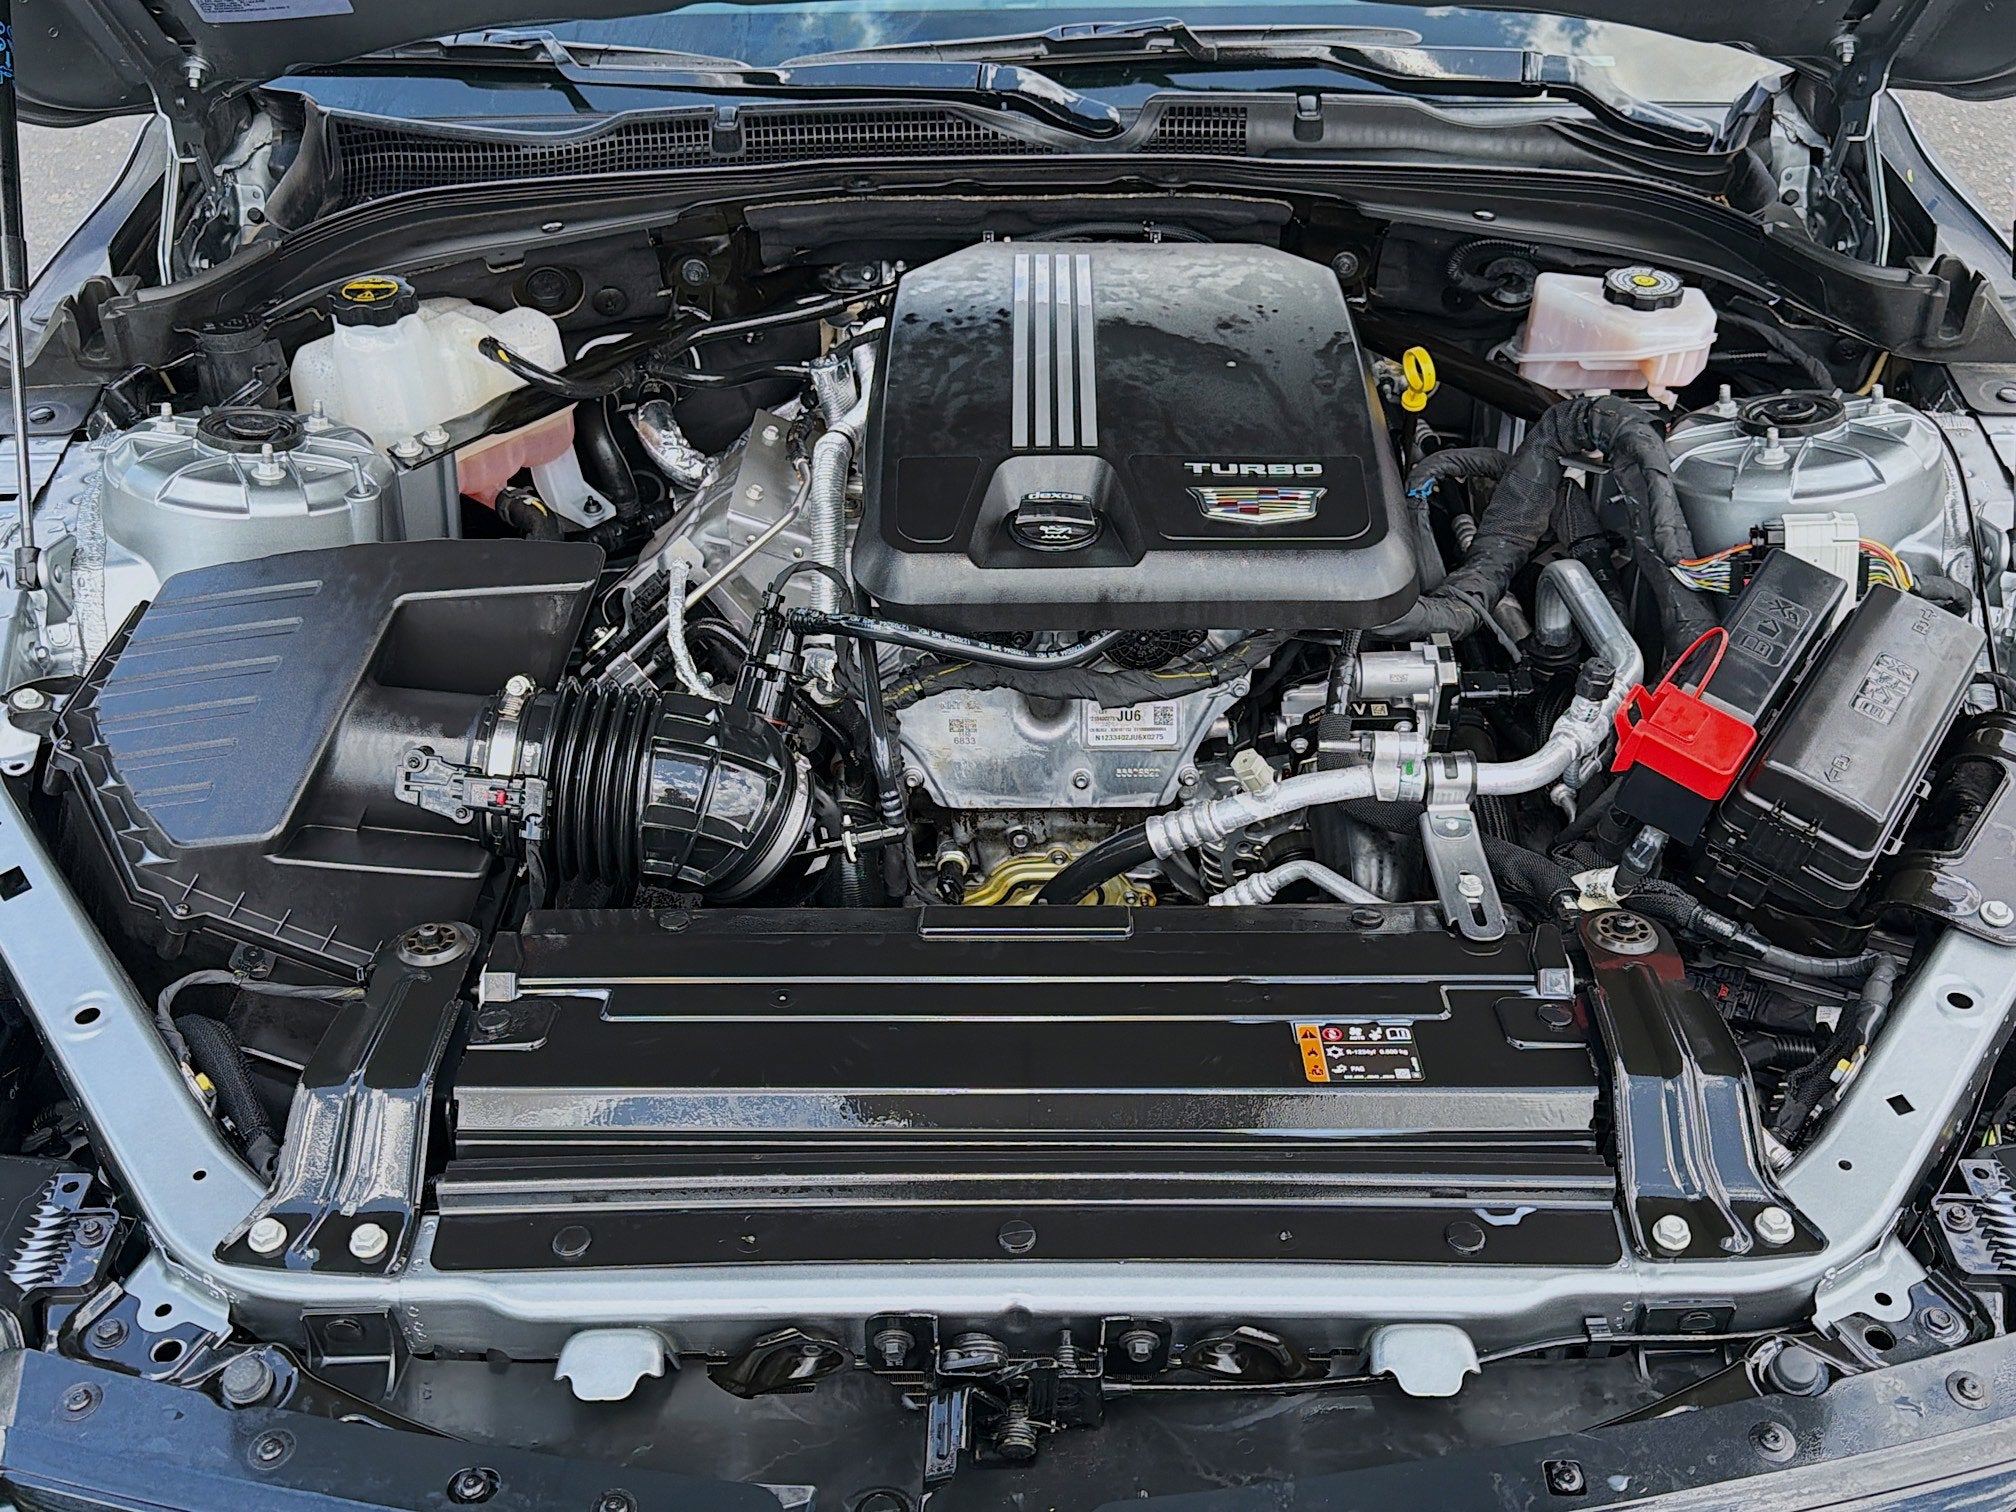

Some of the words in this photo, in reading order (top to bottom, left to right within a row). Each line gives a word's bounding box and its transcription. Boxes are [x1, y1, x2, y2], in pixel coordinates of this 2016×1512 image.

[1184, 463, 1322, 475] TURBO
[1352, 703, 1366, 715] V
[1117, 710, 1141, 721] JU6
[954, 737, 976, 745] 6833
